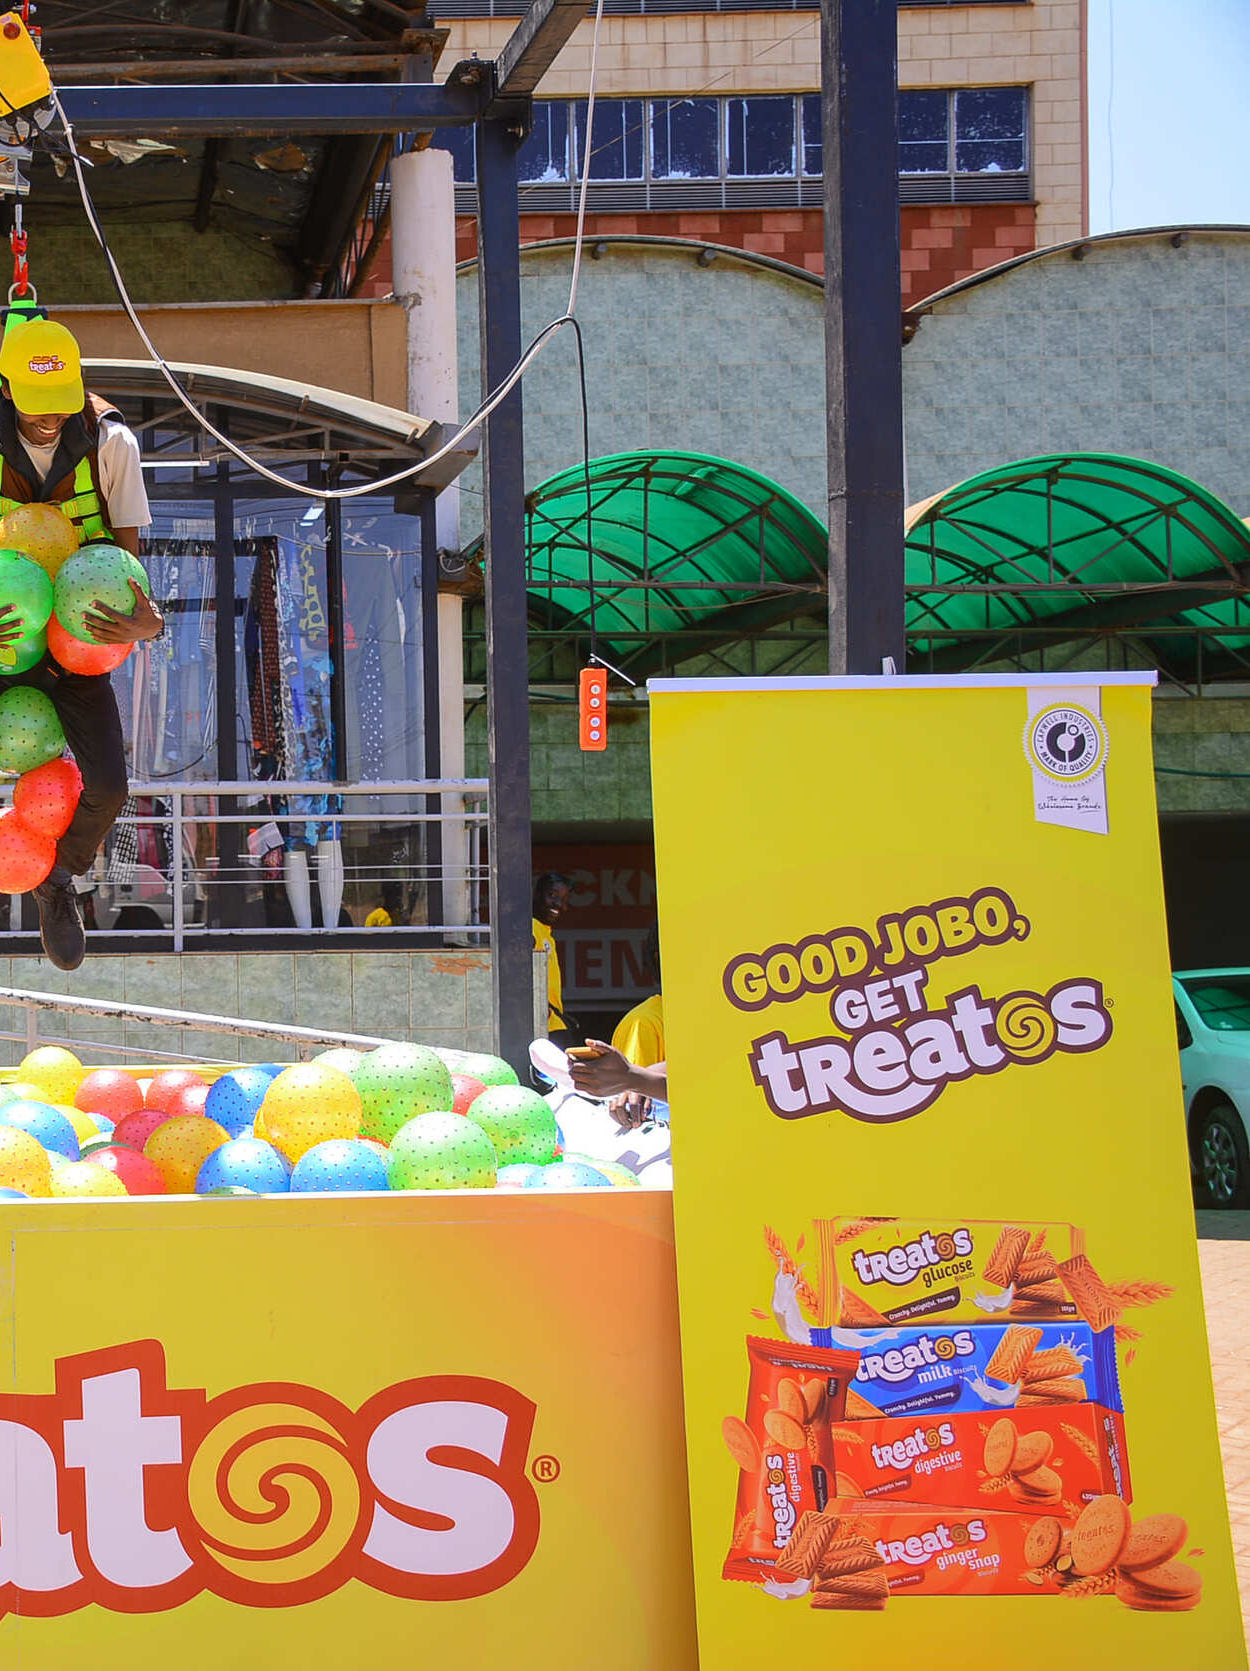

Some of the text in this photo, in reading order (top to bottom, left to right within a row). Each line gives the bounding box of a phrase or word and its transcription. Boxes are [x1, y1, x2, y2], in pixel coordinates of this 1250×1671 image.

[1037, 712, 1095, 743] CAPWELL INDUSTRIES
[1040, 751, 1093, 772] MARK OF QUALITY
[731, 895, 1027, 1004] GOOD JOBO,
[833, 968, 924, 1029] GET
[922, 1257, 973, 1288] glucose
[917, 1363, 953, 1384] milk
[914, 1449, 962, 1475] digestive
[786, 1452, 801, 1503] digestive
[936, 1548, 979, 1571] ginger
[967, 1553, 1000, 1570] snap
